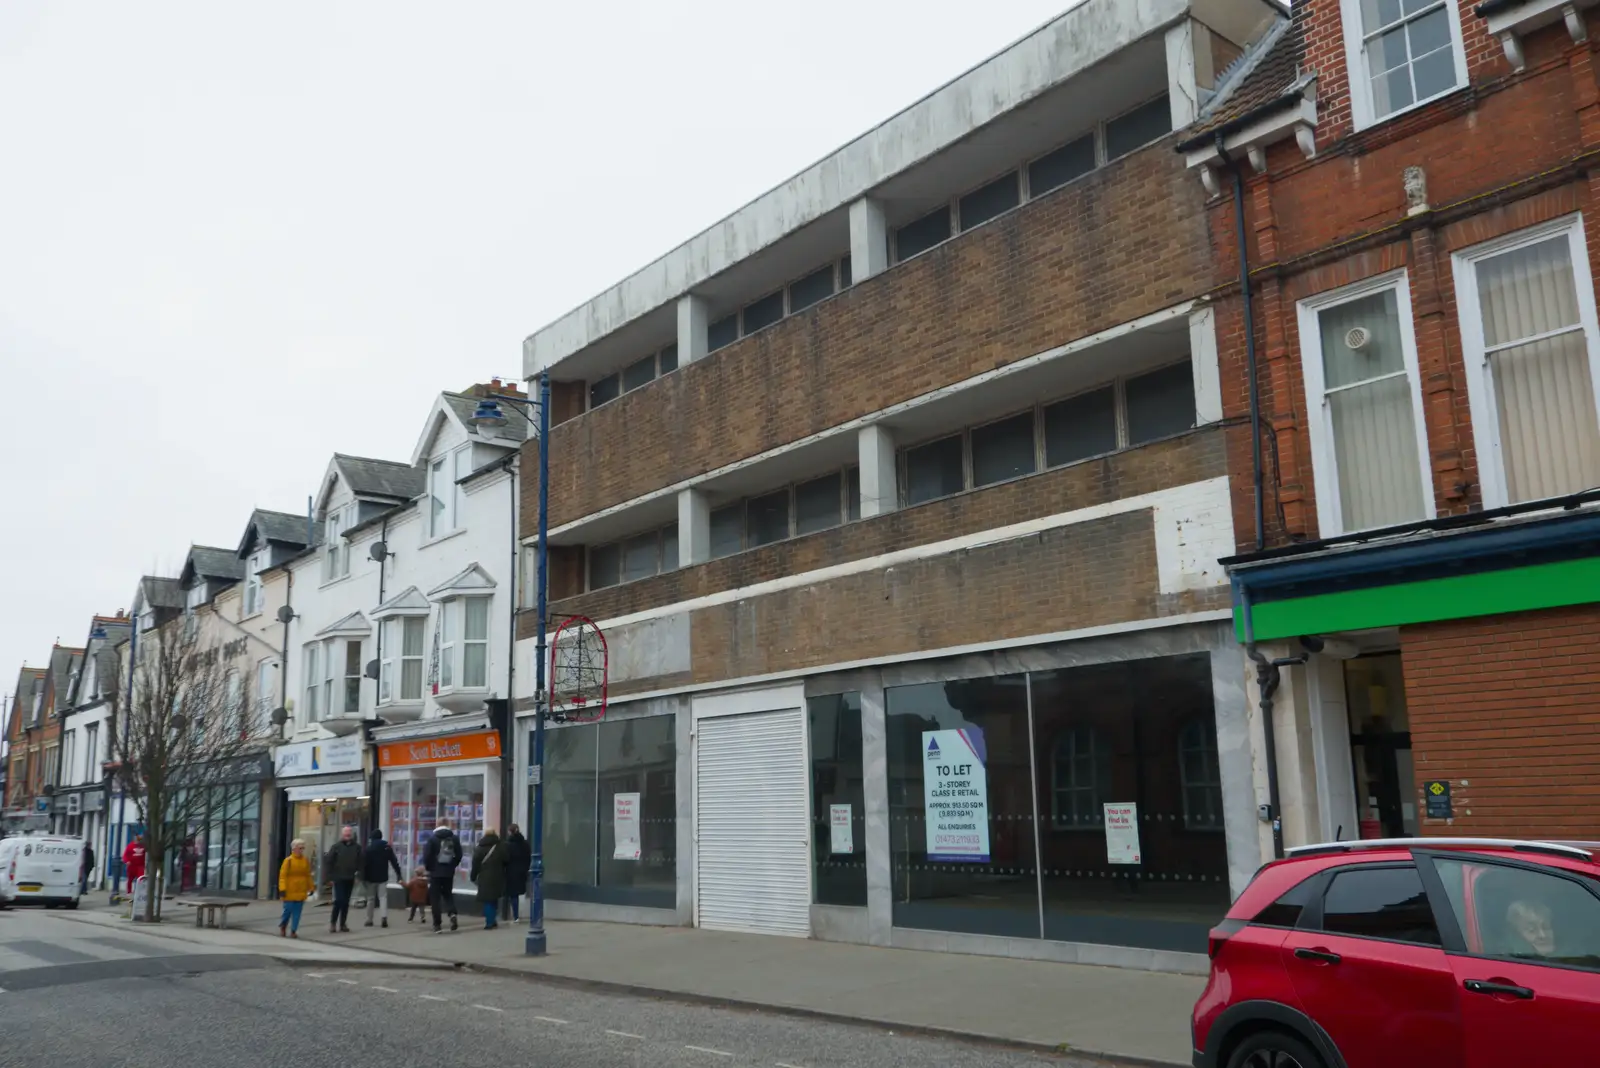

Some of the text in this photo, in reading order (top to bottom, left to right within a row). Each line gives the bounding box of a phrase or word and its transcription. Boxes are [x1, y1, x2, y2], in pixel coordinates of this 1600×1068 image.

[430, 740, 462, 758] Beckett
[936, 764, 972, 776] TO LET
[931, 789, 950, 797] CLASS
[952, 789, 956, 797] E
[1108, 815, 1120, 824] find
[35, 843, 77, 856] Barnes
